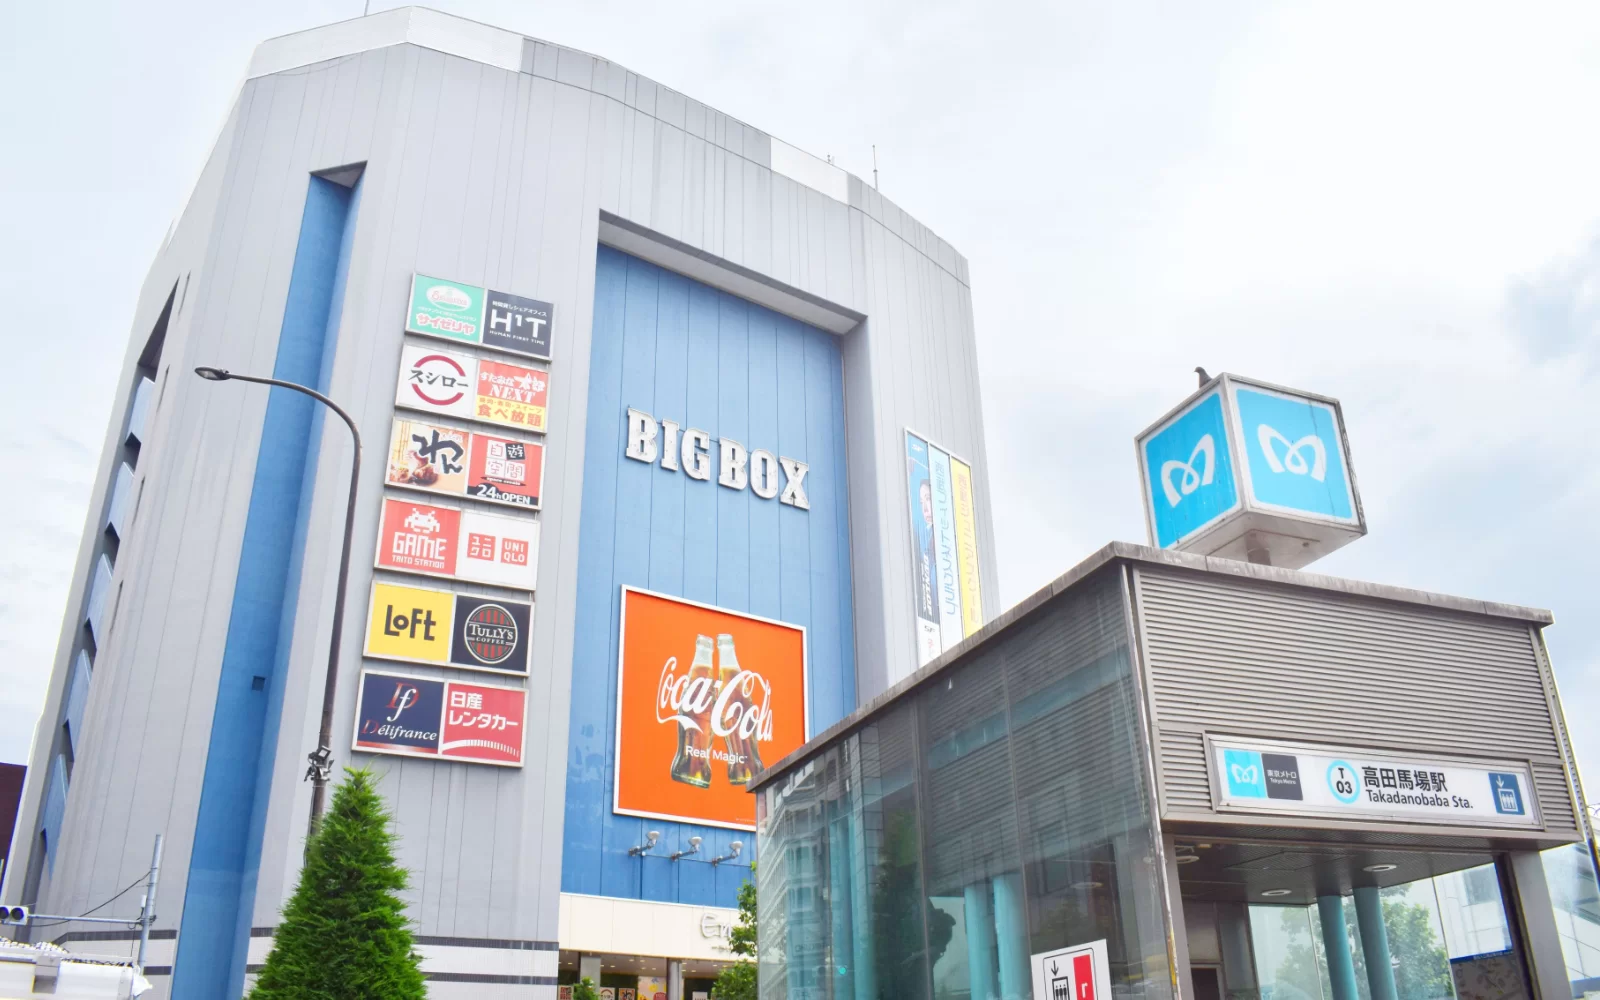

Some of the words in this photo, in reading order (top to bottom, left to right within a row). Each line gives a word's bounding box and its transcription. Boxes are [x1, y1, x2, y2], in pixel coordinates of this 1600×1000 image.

[417, 313, 475, 335] サイゼリヤ
[408, 369, 469, 388] スシロー
[488, 384, 536, 404] NEXT
[478, 404, 541, 426] 食べ放題
[626, 407, 710, 481] BIG
[718, 436, 810, 511] BOX
[393, 531, 447, 560] GAME
[504, 541, 524, 553] UNI
[392, 554, 412, 564] TAITO
[414, 557, 444, 569] STATION
[503, 552, 525, 563] QLO
[475, 637, 505, 645] COFFEE
[450, 691, 482, 710] 日産
[361, 719, 437, 741] Délifrance
[449, 711, 519, 730] レンタカー
[685, 745, 710, 759] Real
[1267, 769, 1297, 779] 東京メトロ
[1338, 767, 1344, 779] T
[1362, 766, 1448, 792] 高田馬場駅
[1336, 780, 1353, 794] 03
[1366, 789, 1449, 807] Takadanobaba
[1453, 795, 1474, 809] Sta.
